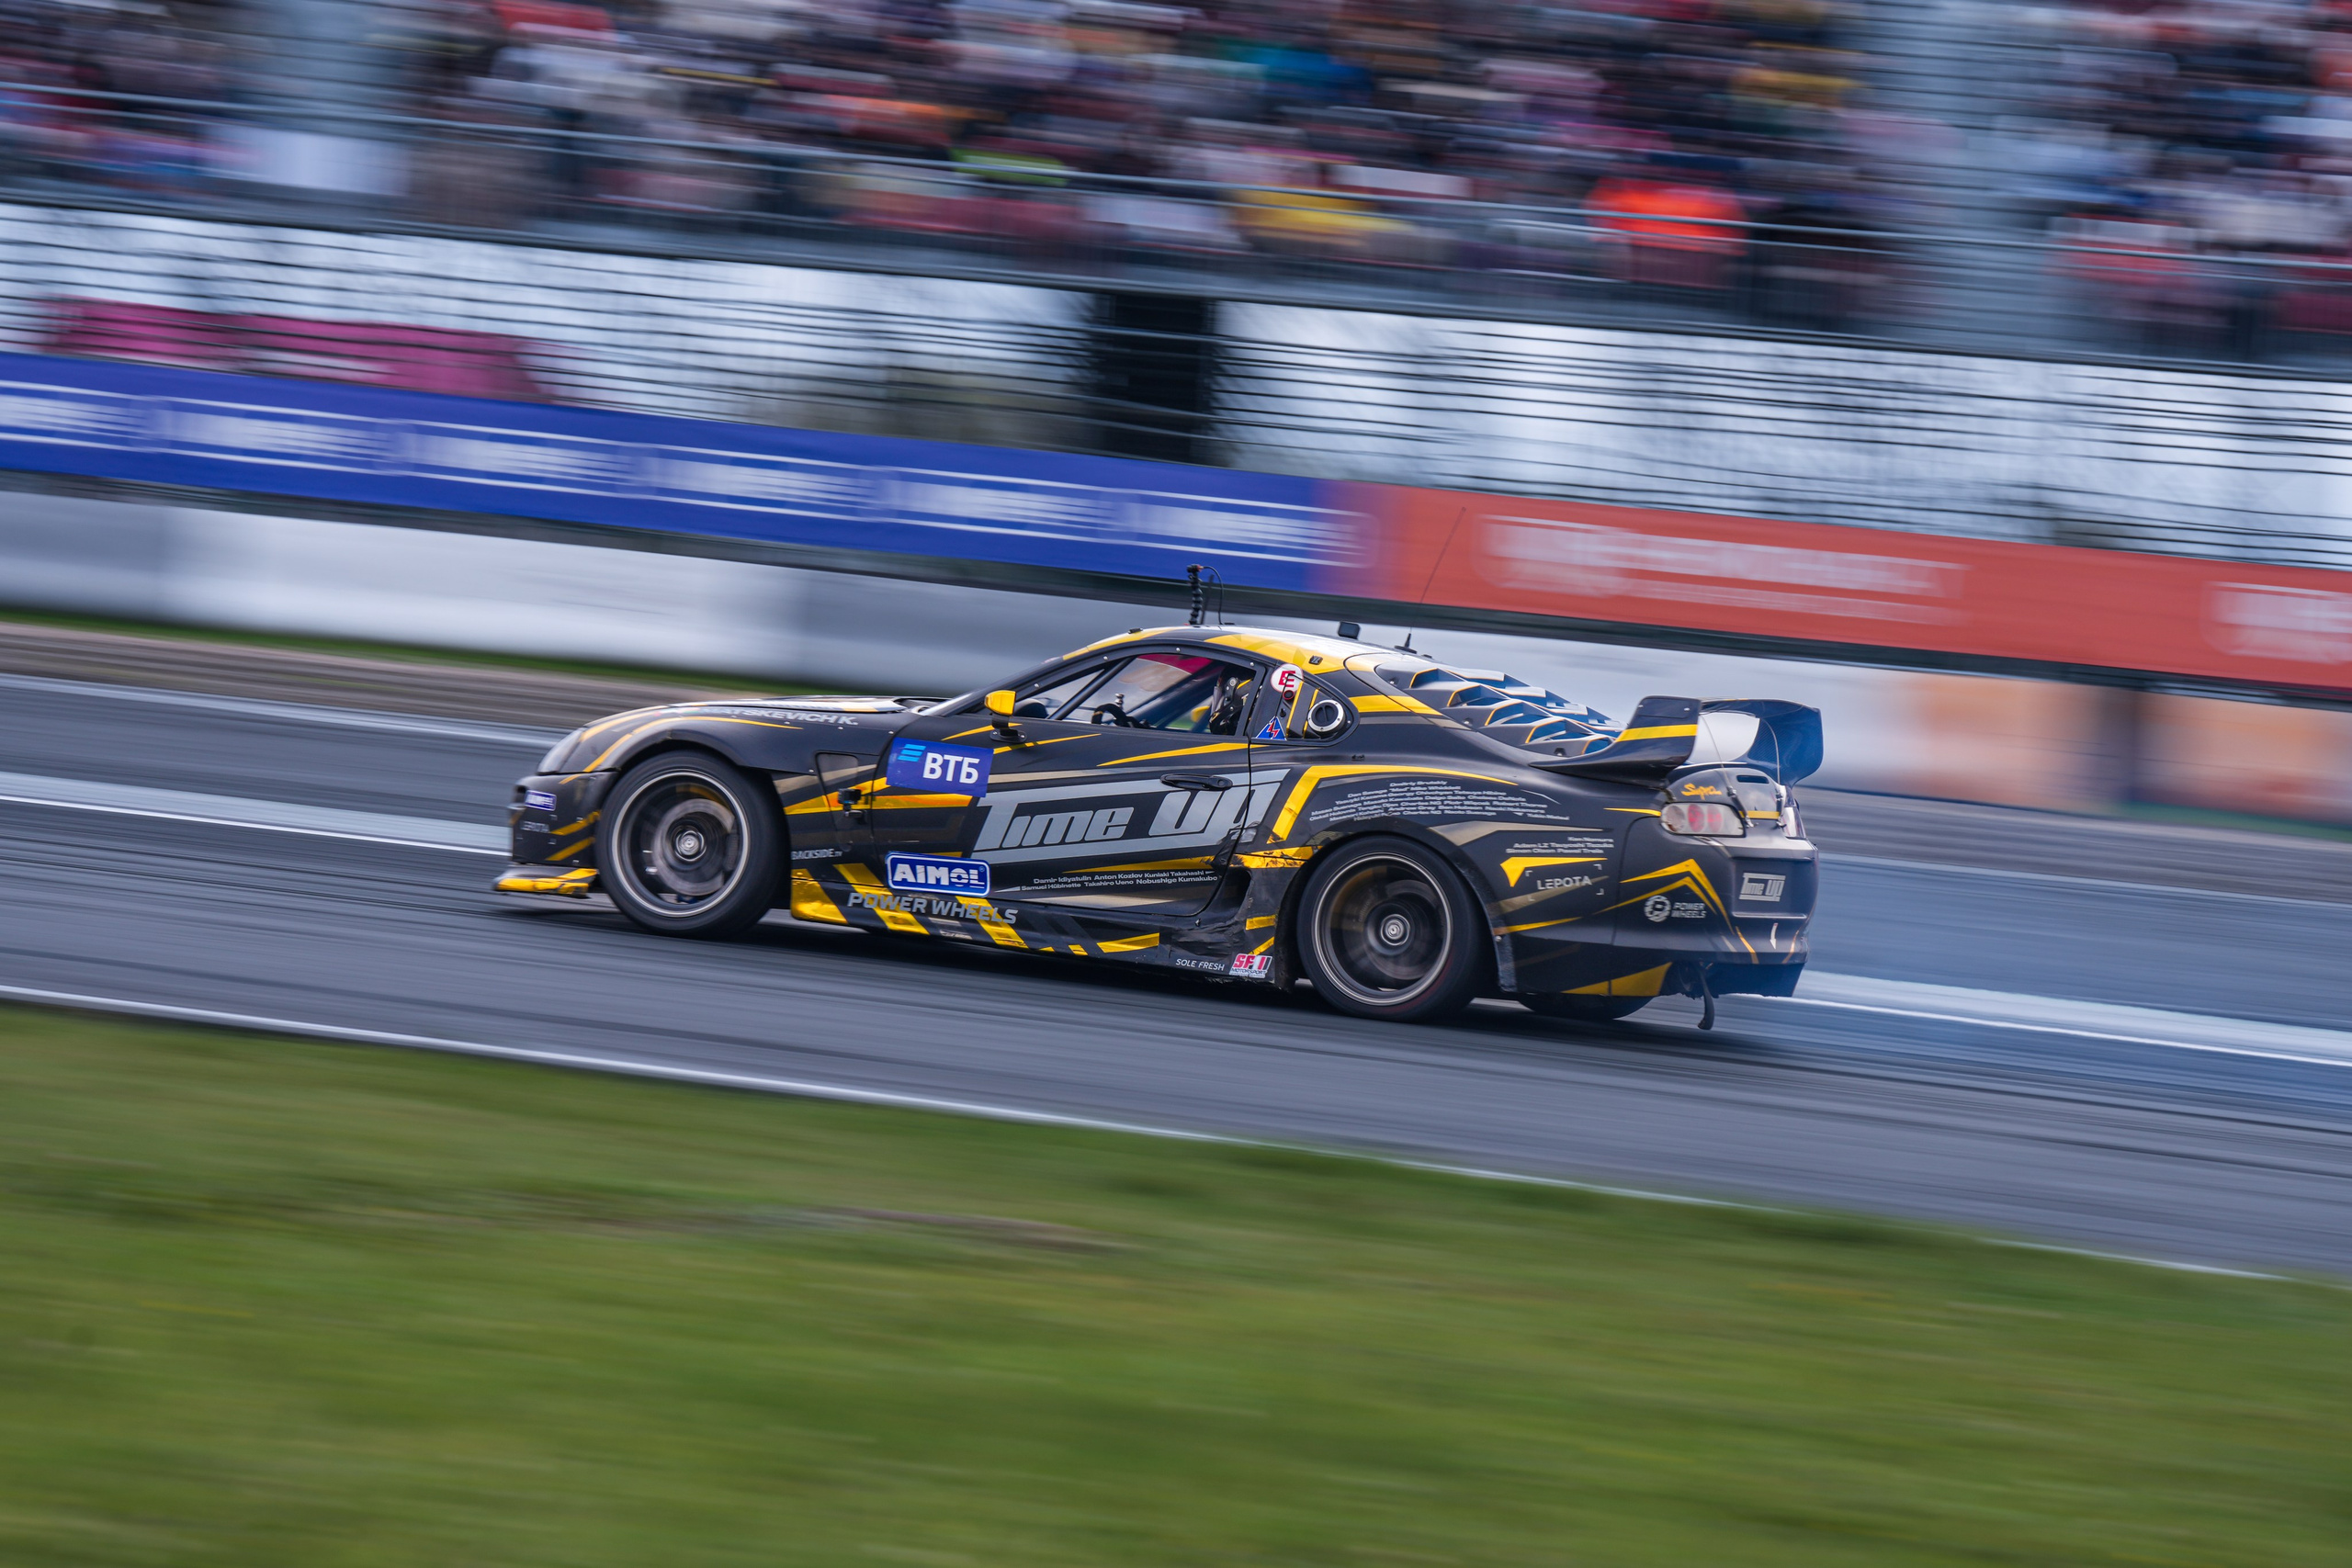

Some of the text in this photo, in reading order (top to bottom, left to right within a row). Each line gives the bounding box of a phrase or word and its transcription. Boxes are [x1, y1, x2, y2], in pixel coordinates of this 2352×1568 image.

[1278, 671, 1296, 687] E
[922, 752, 980, 784] ВТБ
[893, 863, 986, 889] AIMOL
[1083, 879, 1114, 887] Takahiro
[1136, 876, 1177, 885] Nobushige
[1177, 874, 1217, 883] Kumakubo
[1536, 875, 1593, 890] LEPOTA
[847, 892, 1019, 924] POWER WHEELS
[1673, 902, 1706, 910] POWER
[1671, 910, 1708, 919] WHEELS
[1175, 958, 1226, 972] SOLE FRESH
